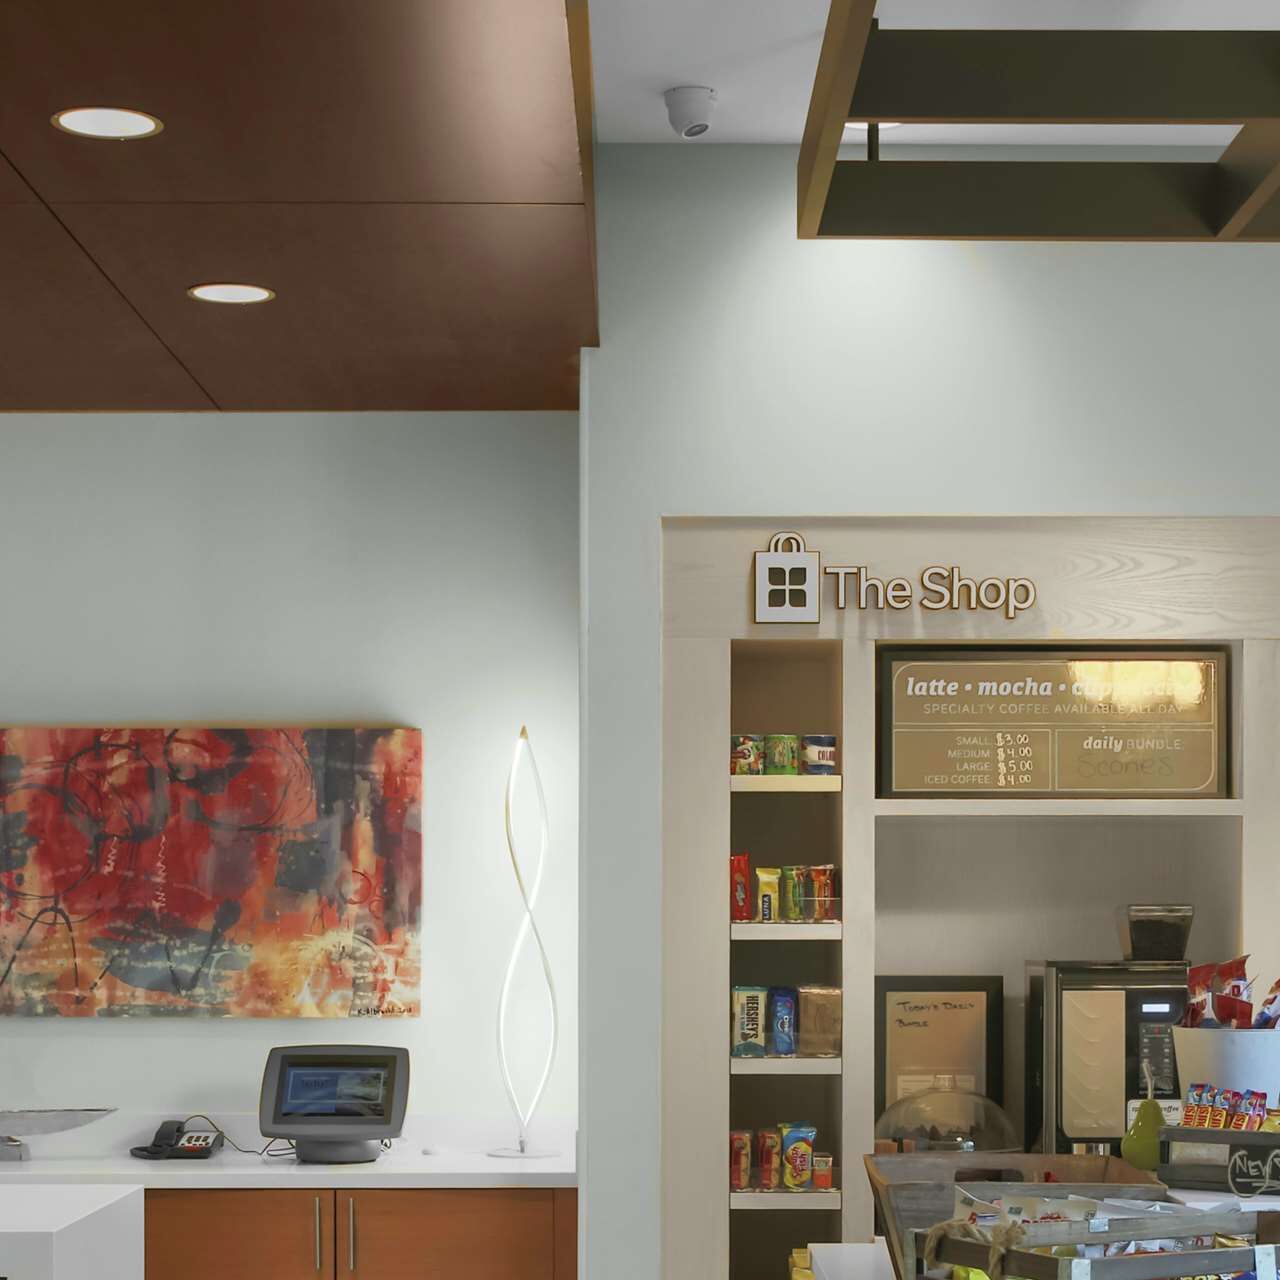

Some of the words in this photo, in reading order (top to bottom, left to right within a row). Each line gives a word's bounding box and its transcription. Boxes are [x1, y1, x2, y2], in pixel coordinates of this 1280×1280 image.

[824, 565, 913, 610] The
[920, 565, 1037, 619] Shop
[906, 677, 959, 697] latte
[977, 677, 1053, 697] mocha
[923, 703, 995, 715] SPECIALTY
[999, 703, 1050, 715] COFFEE
[1054, 703, 1125, 715] AVAILABLE
[996, 733, 1029, 747] $3.00
[1083, 736, 1123, 753] daily
[997, 747, 1032, 761] $4.00
[998, 760, 1033, 774] $5.00
[924, 775, 948, 785] ICED
[997, 774, 1032, 787] $4.00
[746, 995, 760, 1040] HERSHEY'S
